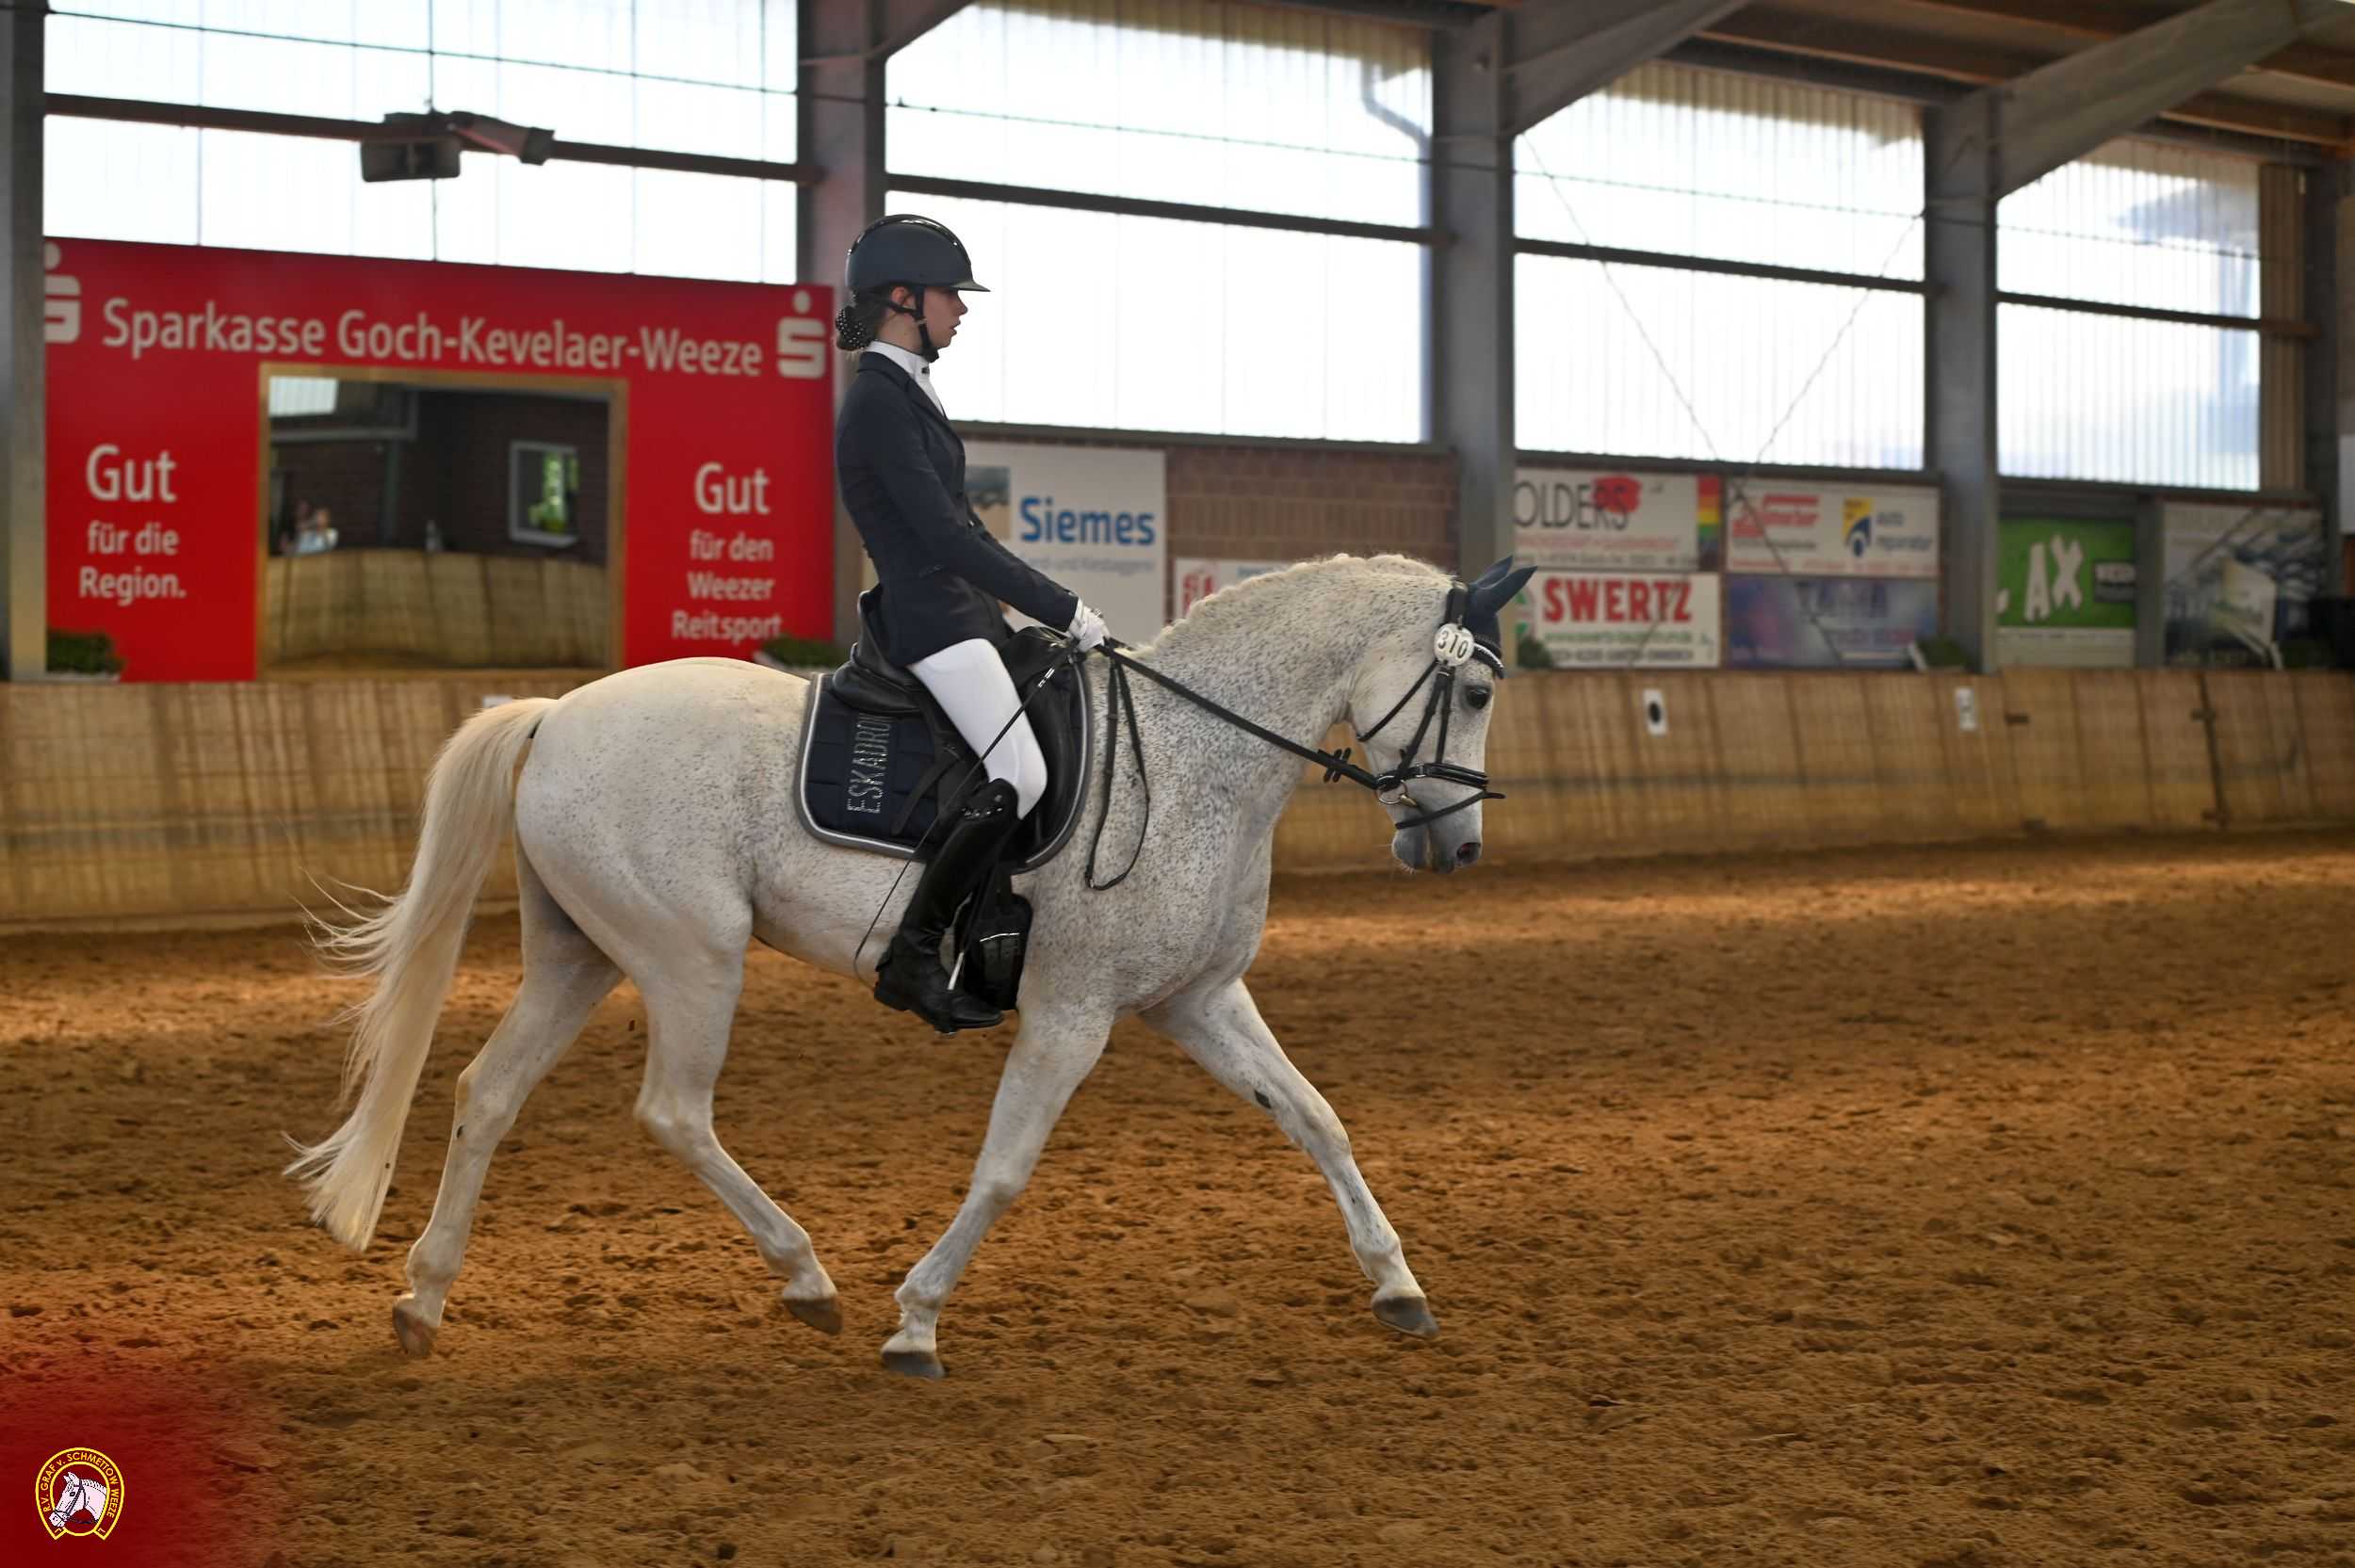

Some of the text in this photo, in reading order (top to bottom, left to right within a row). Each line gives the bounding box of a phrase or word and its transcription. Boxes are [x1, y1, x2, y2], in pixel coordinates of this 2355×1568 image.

[102, 297, 763, 376] Sparkasse Goch-Kevelaer-Weeze
[86, 443, 177, 503] Gut
[694, 461, 771, 514] Gut
[88, 519, 180, 556] für die
[1019, 494, 1156, 546] Siemes
[690, 528, 775, 561] für den
[78, 564, 187, 606] Region.
[687, 571, 775, 601] Weezer
[1542, 577, 1692, 623] SWERTZ
[671, 608, 782, 646] Reitsport
